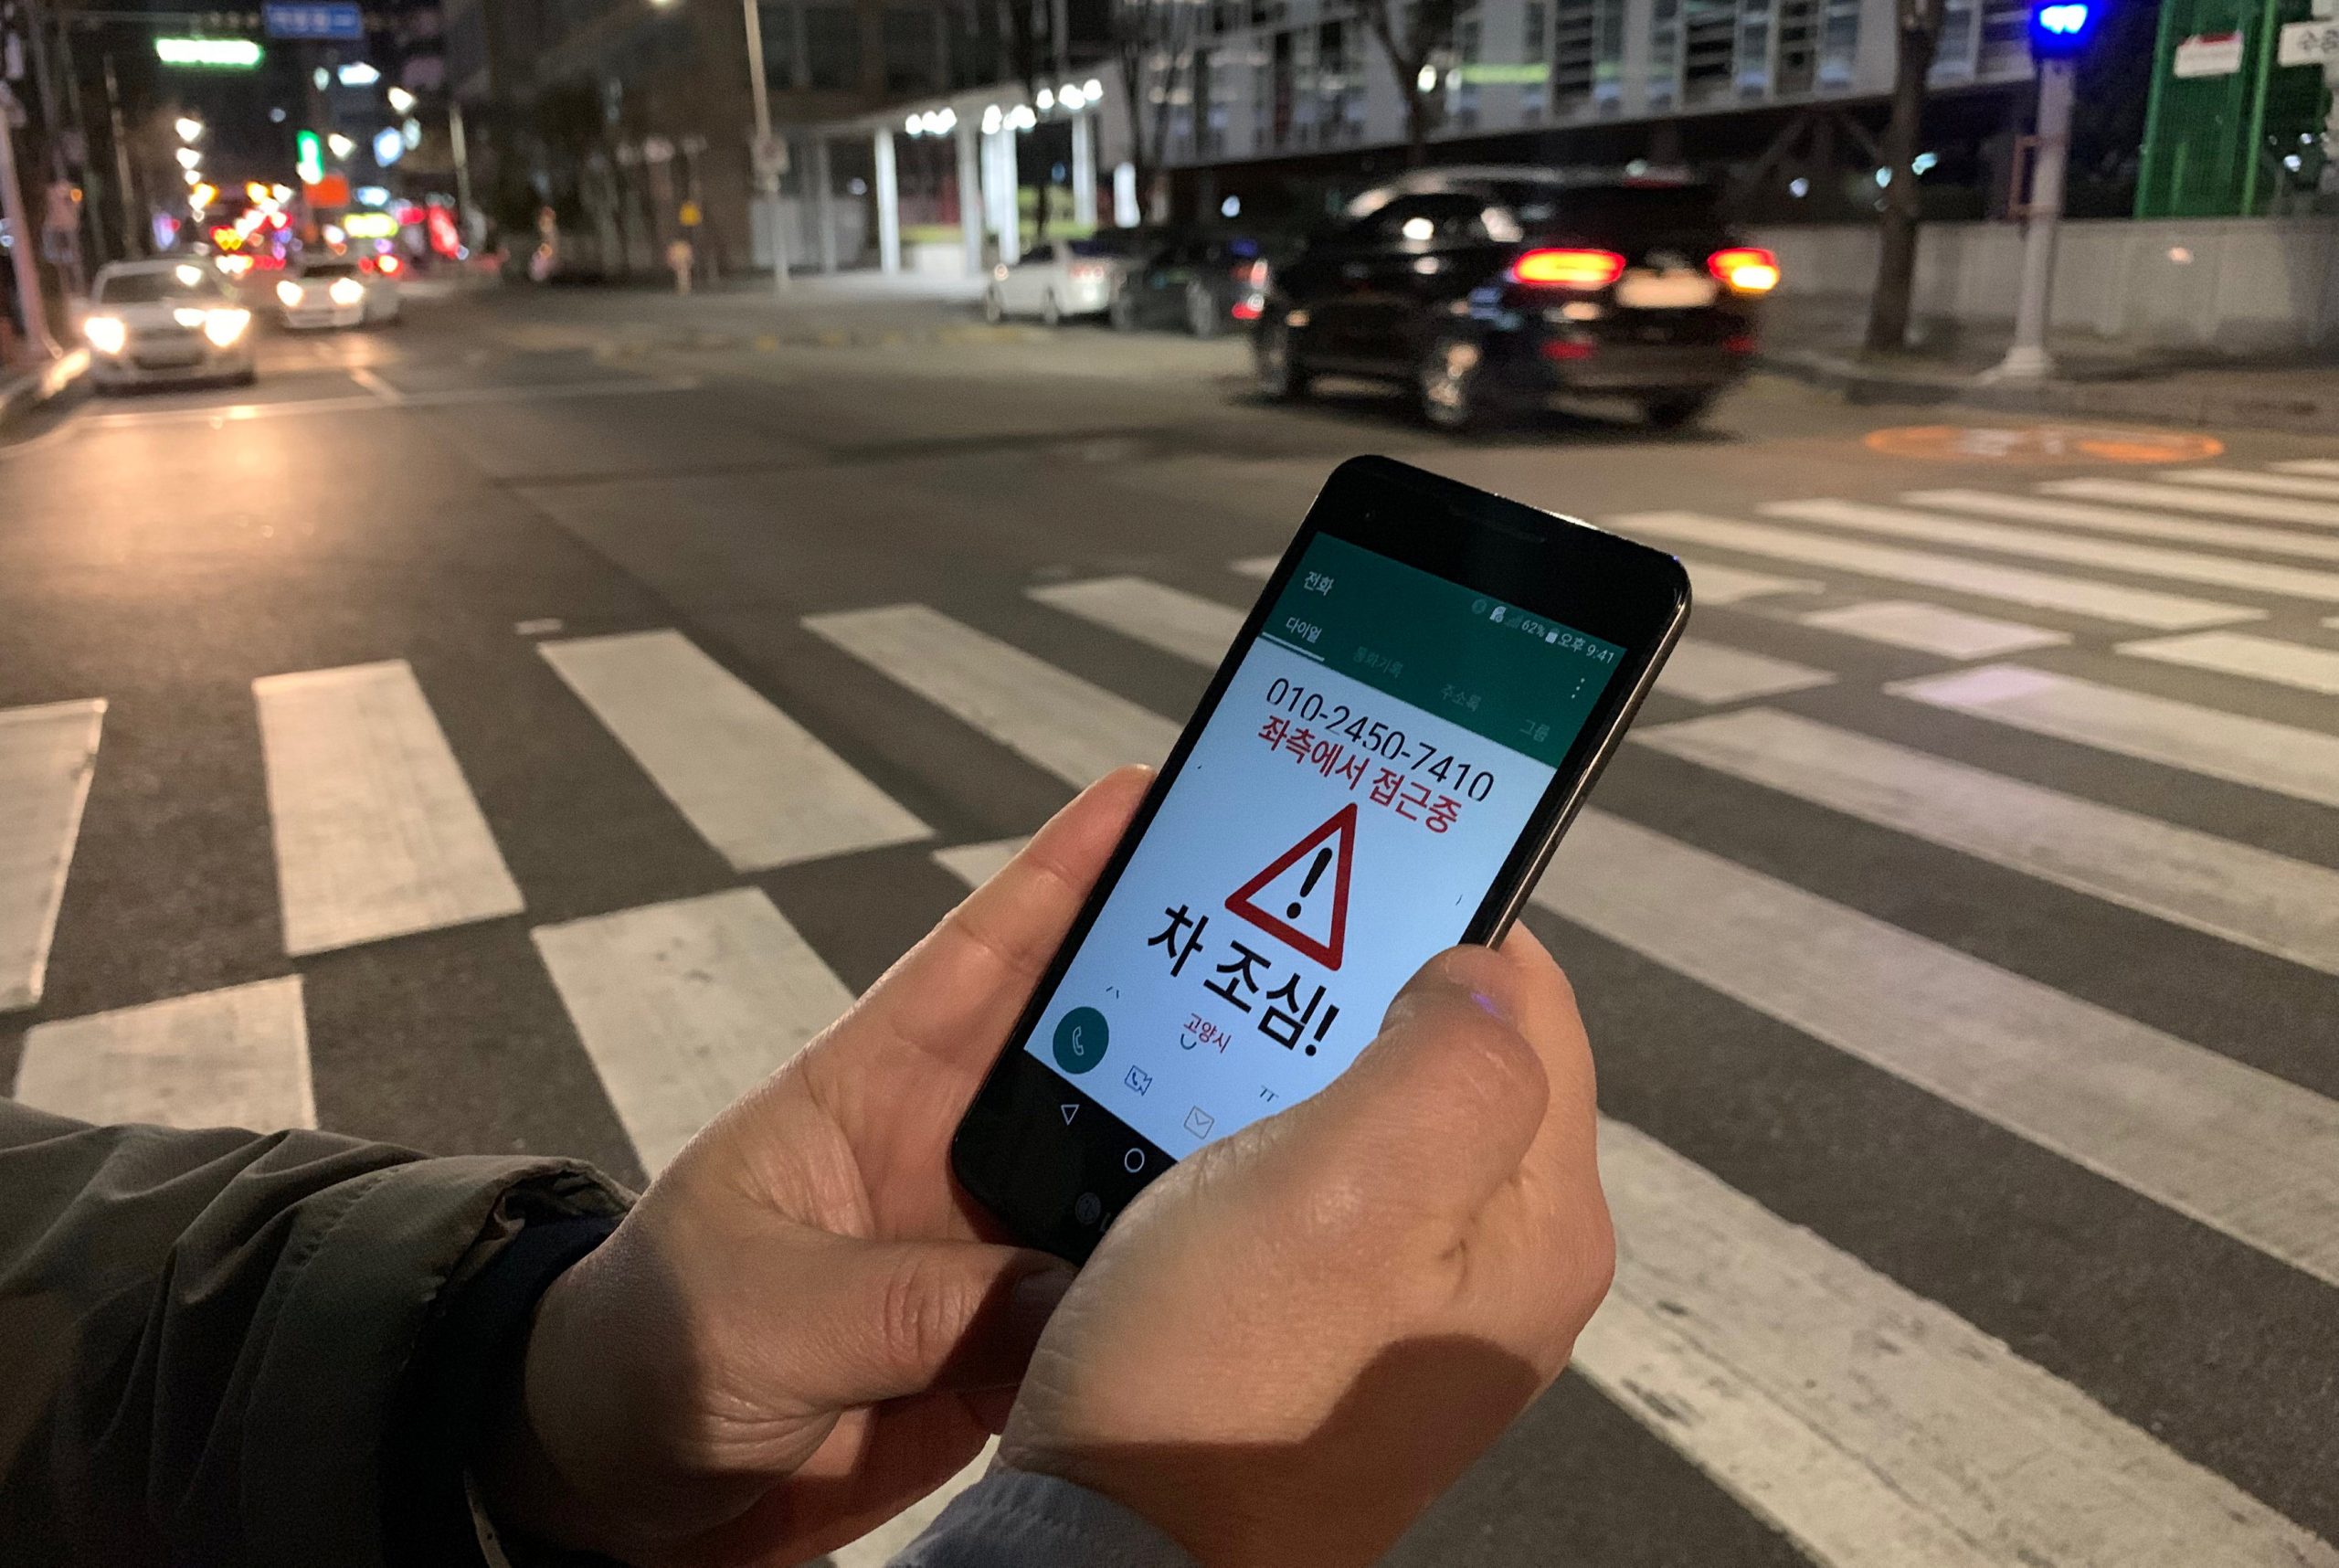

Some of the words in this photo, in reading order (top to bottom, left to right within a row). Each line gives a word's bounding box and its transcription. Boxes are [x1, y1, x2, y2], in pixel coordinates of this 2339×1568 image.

[1303, 570, 1336, 597] 전화
[1521, 619, 1546, 638] 62%
[1557, 632, 1586, 652] 오후
[1586, 643, 1615, 664] 9:41
[1257, 715, 1371, 791] 좌측에서
[1369, 767, 1463, 833] 접근중
[1265, 677, 1495, 802] 010-2450-7410
[1147, 904, 1210, 978] 차
[1202, 939, 1340, 1057] 조심!
[1182, 1012, 1232, 1054] 고양시
